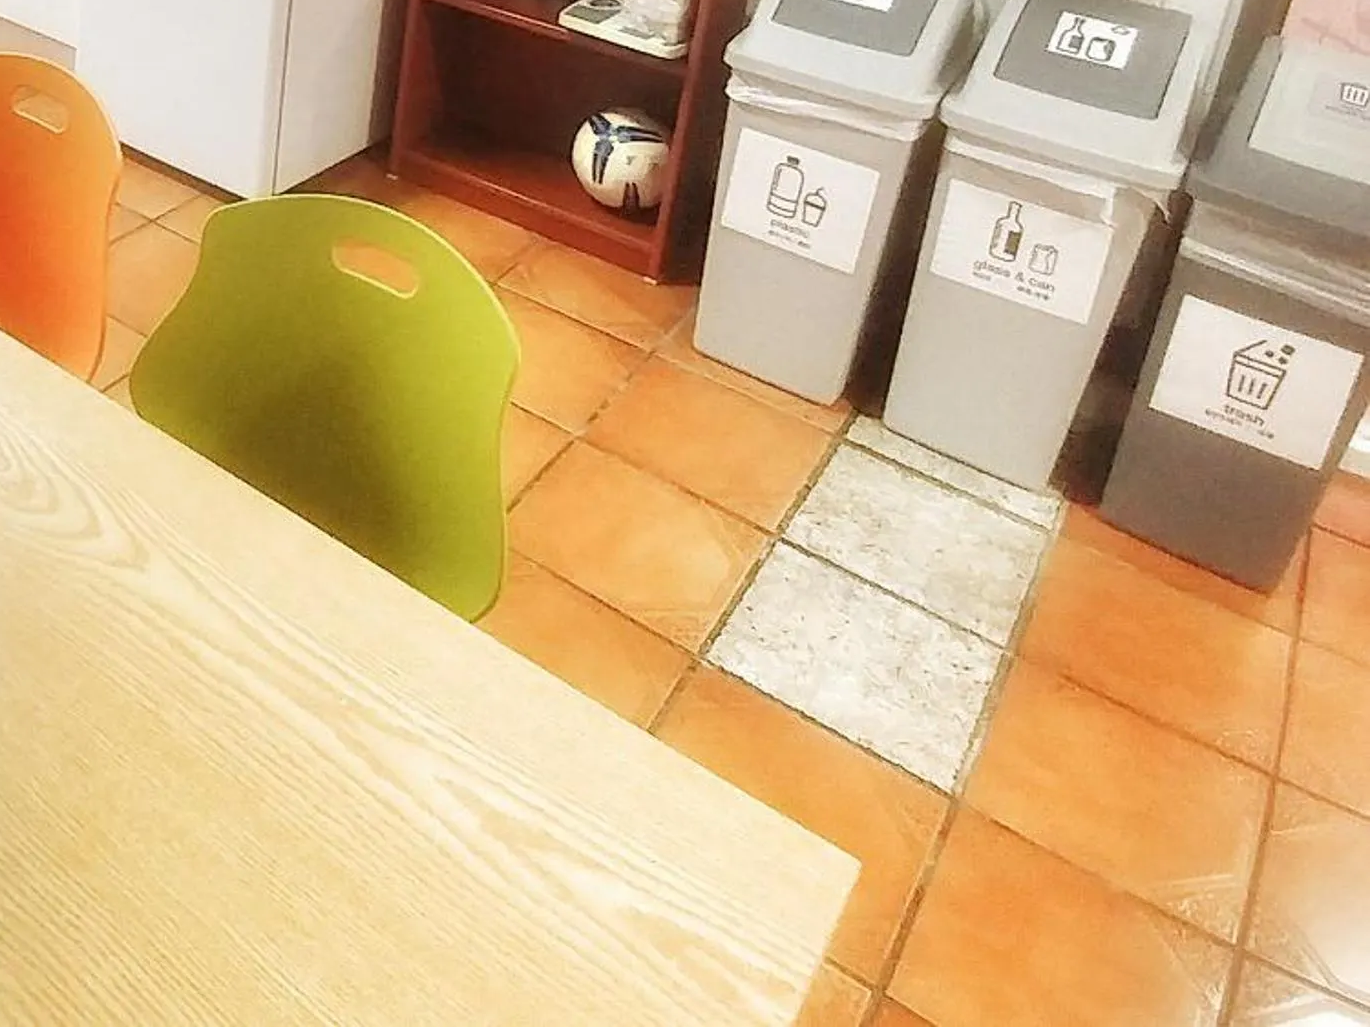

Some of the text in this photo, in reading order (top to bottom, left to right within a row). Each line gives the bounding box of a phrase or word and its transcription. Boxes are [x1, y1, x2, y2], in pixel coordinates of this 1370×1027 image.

[770, 219, 810, 238] plastic
[973, 260, 1011, 278] glass
[1015, 271, 1025, 283] &
[1028, 277, 1055, 293] can
[1224, 405, 1264, 427] trash
